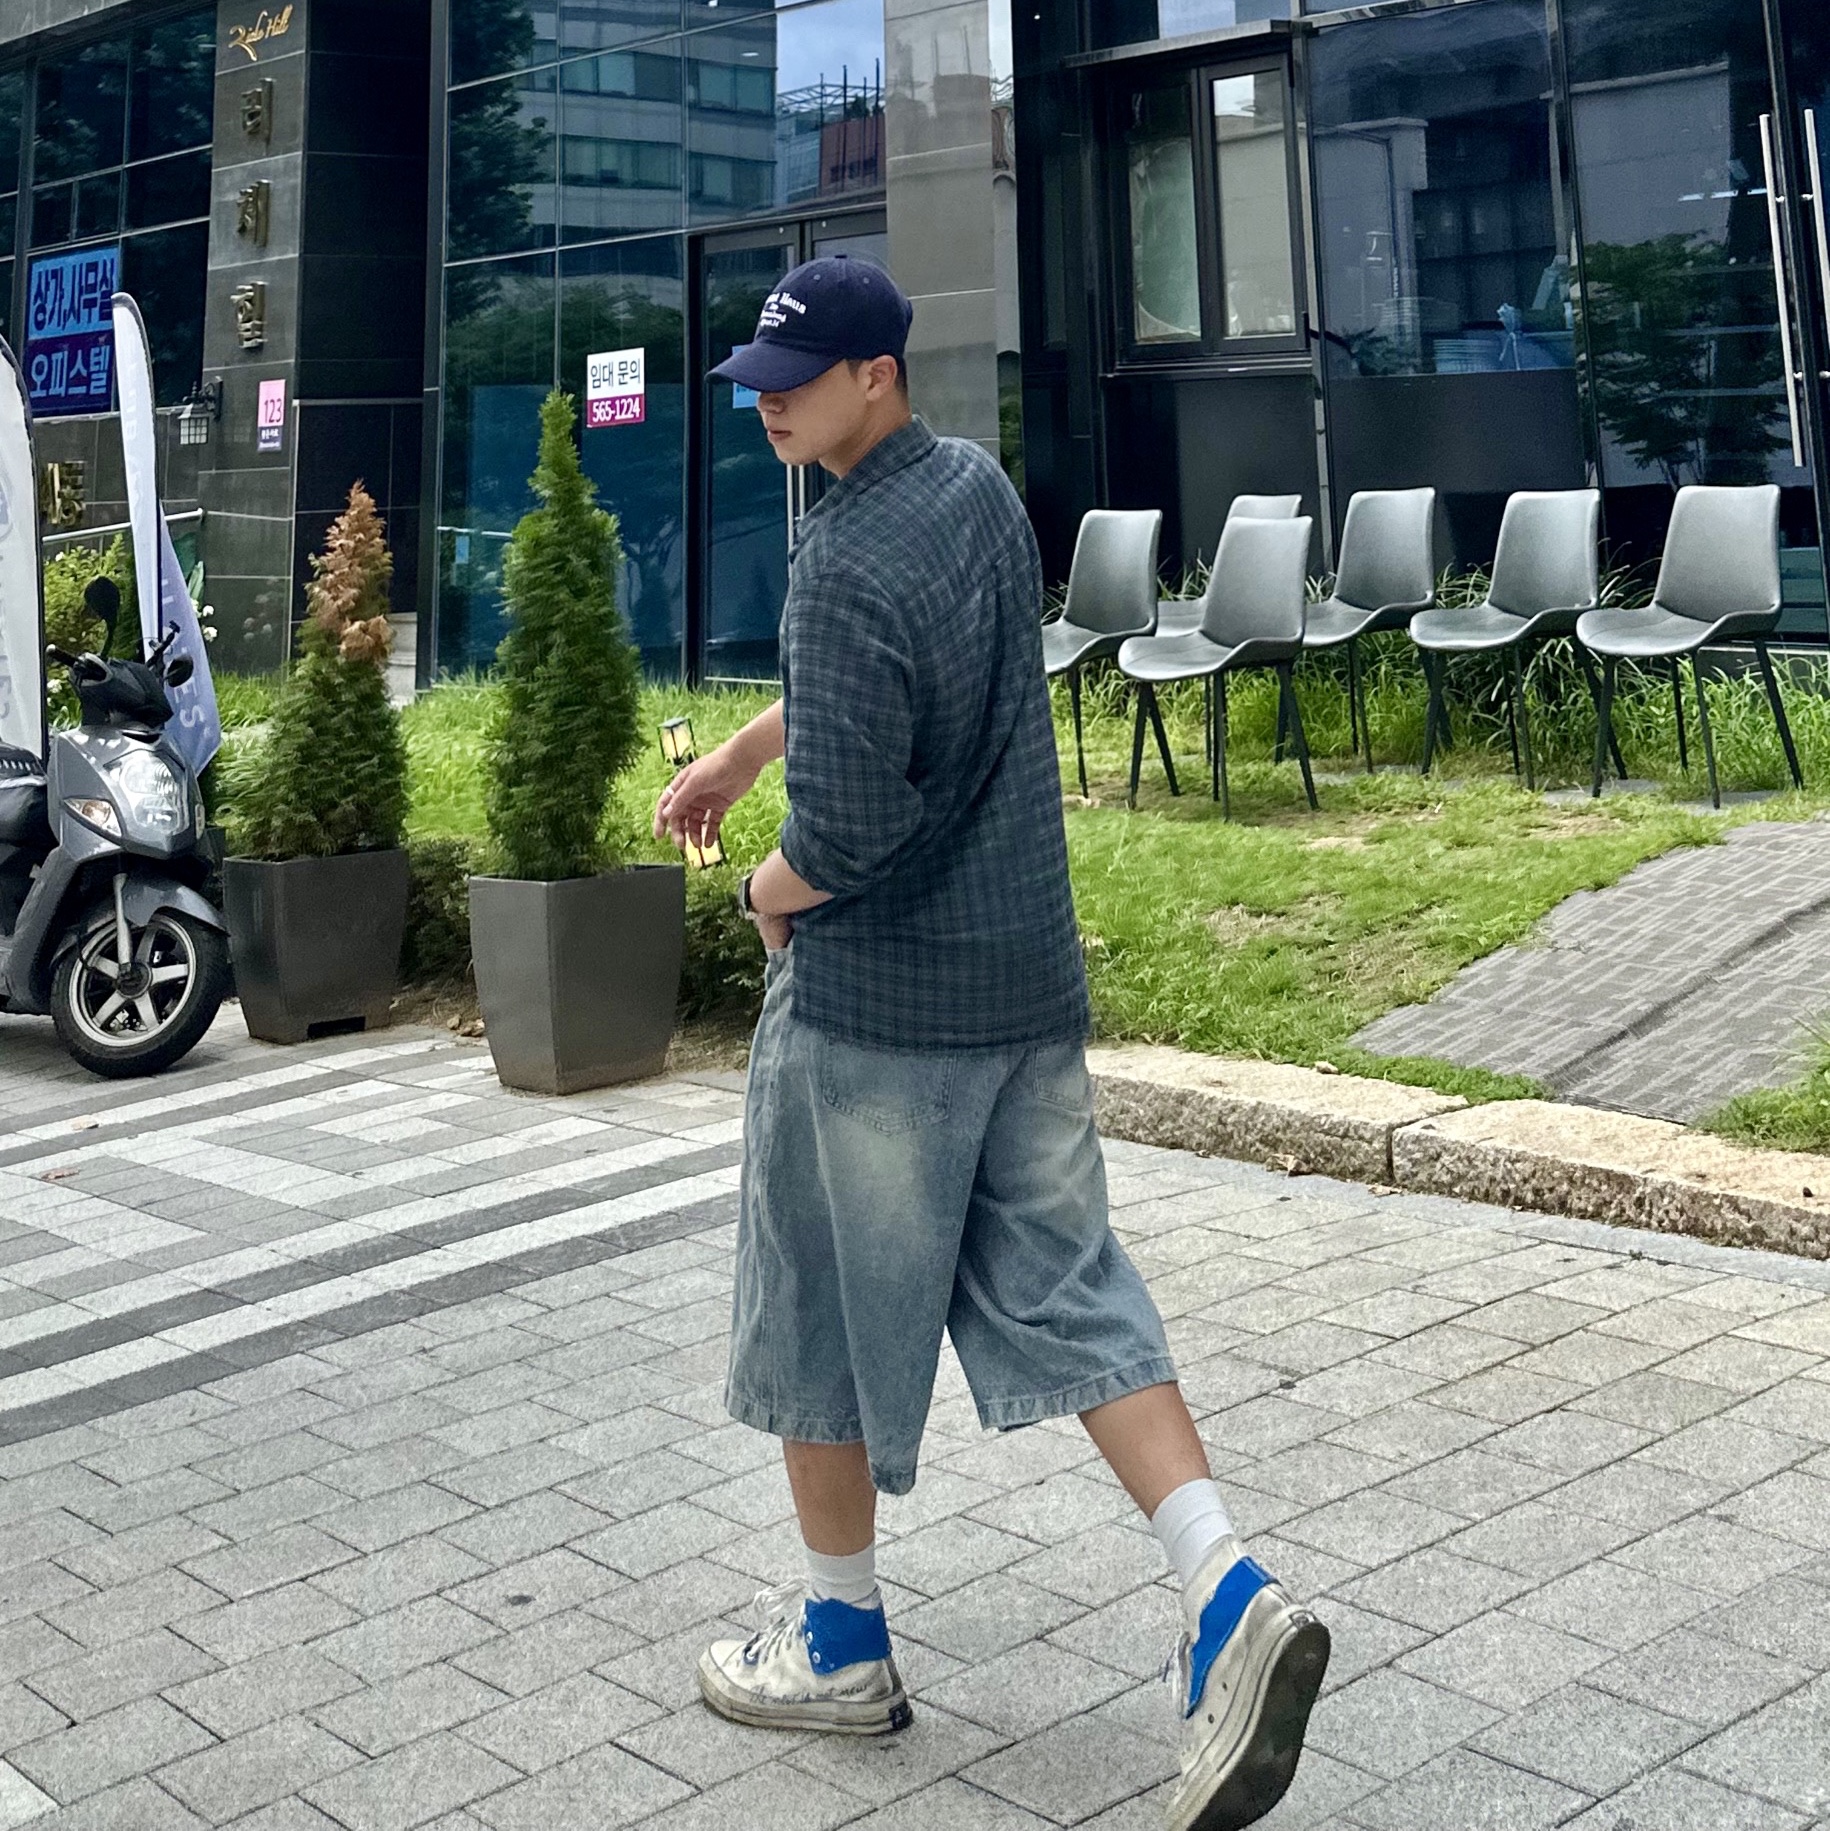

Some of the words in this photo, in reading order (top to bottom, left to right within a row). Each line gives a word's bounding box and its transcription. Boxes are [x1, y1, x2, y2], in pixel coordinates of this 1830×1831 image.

[29, 345, 111, 399] 오피스텔
[590, 361, 614, 389] 임대
[617, 357, 641, 386] 문의
[264, 398, 283, 424] 123
[592, 397, 641, 423] 565-1224
